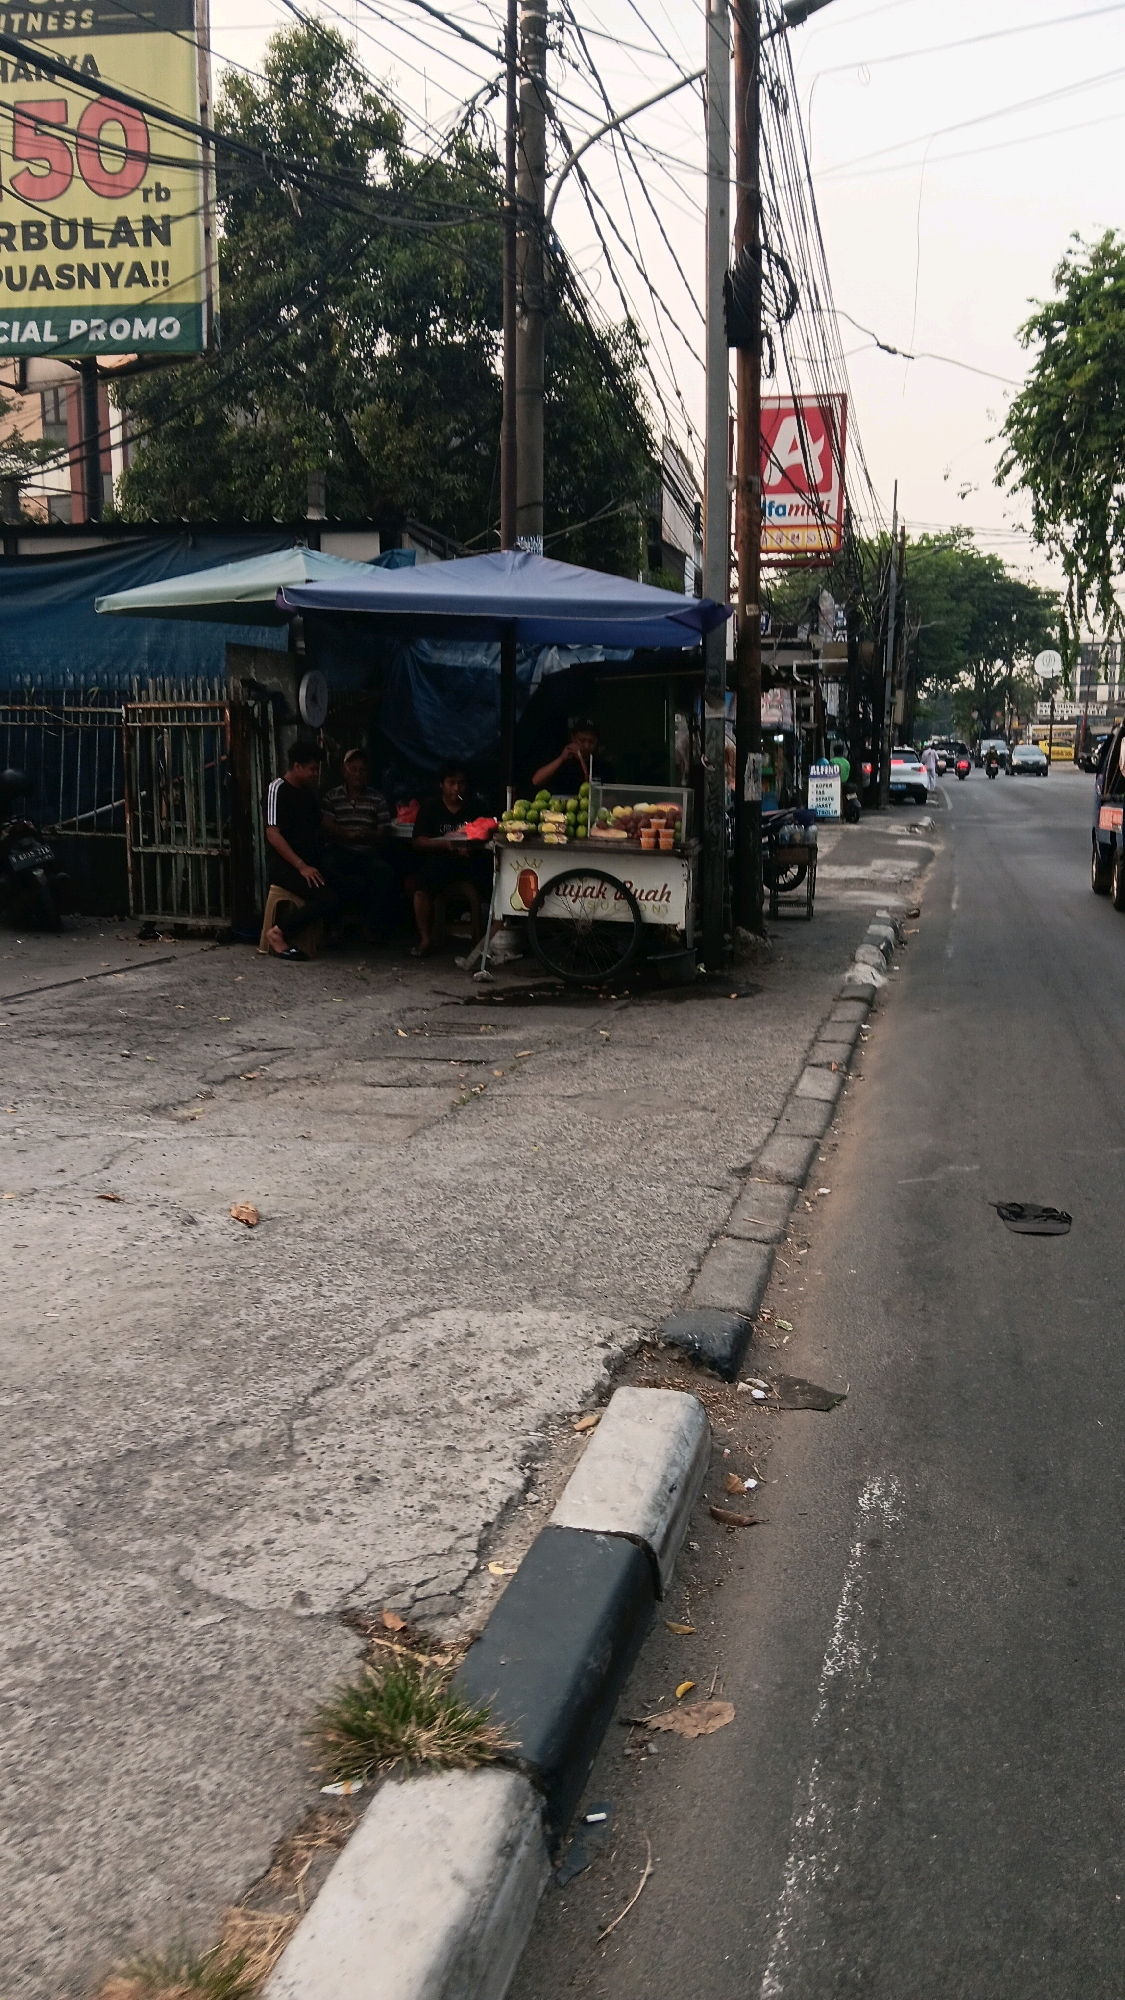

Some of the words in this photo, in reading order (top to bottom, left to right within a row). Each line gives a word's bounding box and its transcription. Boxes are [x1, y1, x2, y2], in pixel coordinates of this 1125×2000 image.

[0, 95, 150, 202] 50
[0, 260, 170, 292] UASNYA!!
[69, 316, 181, 341] PROMO
